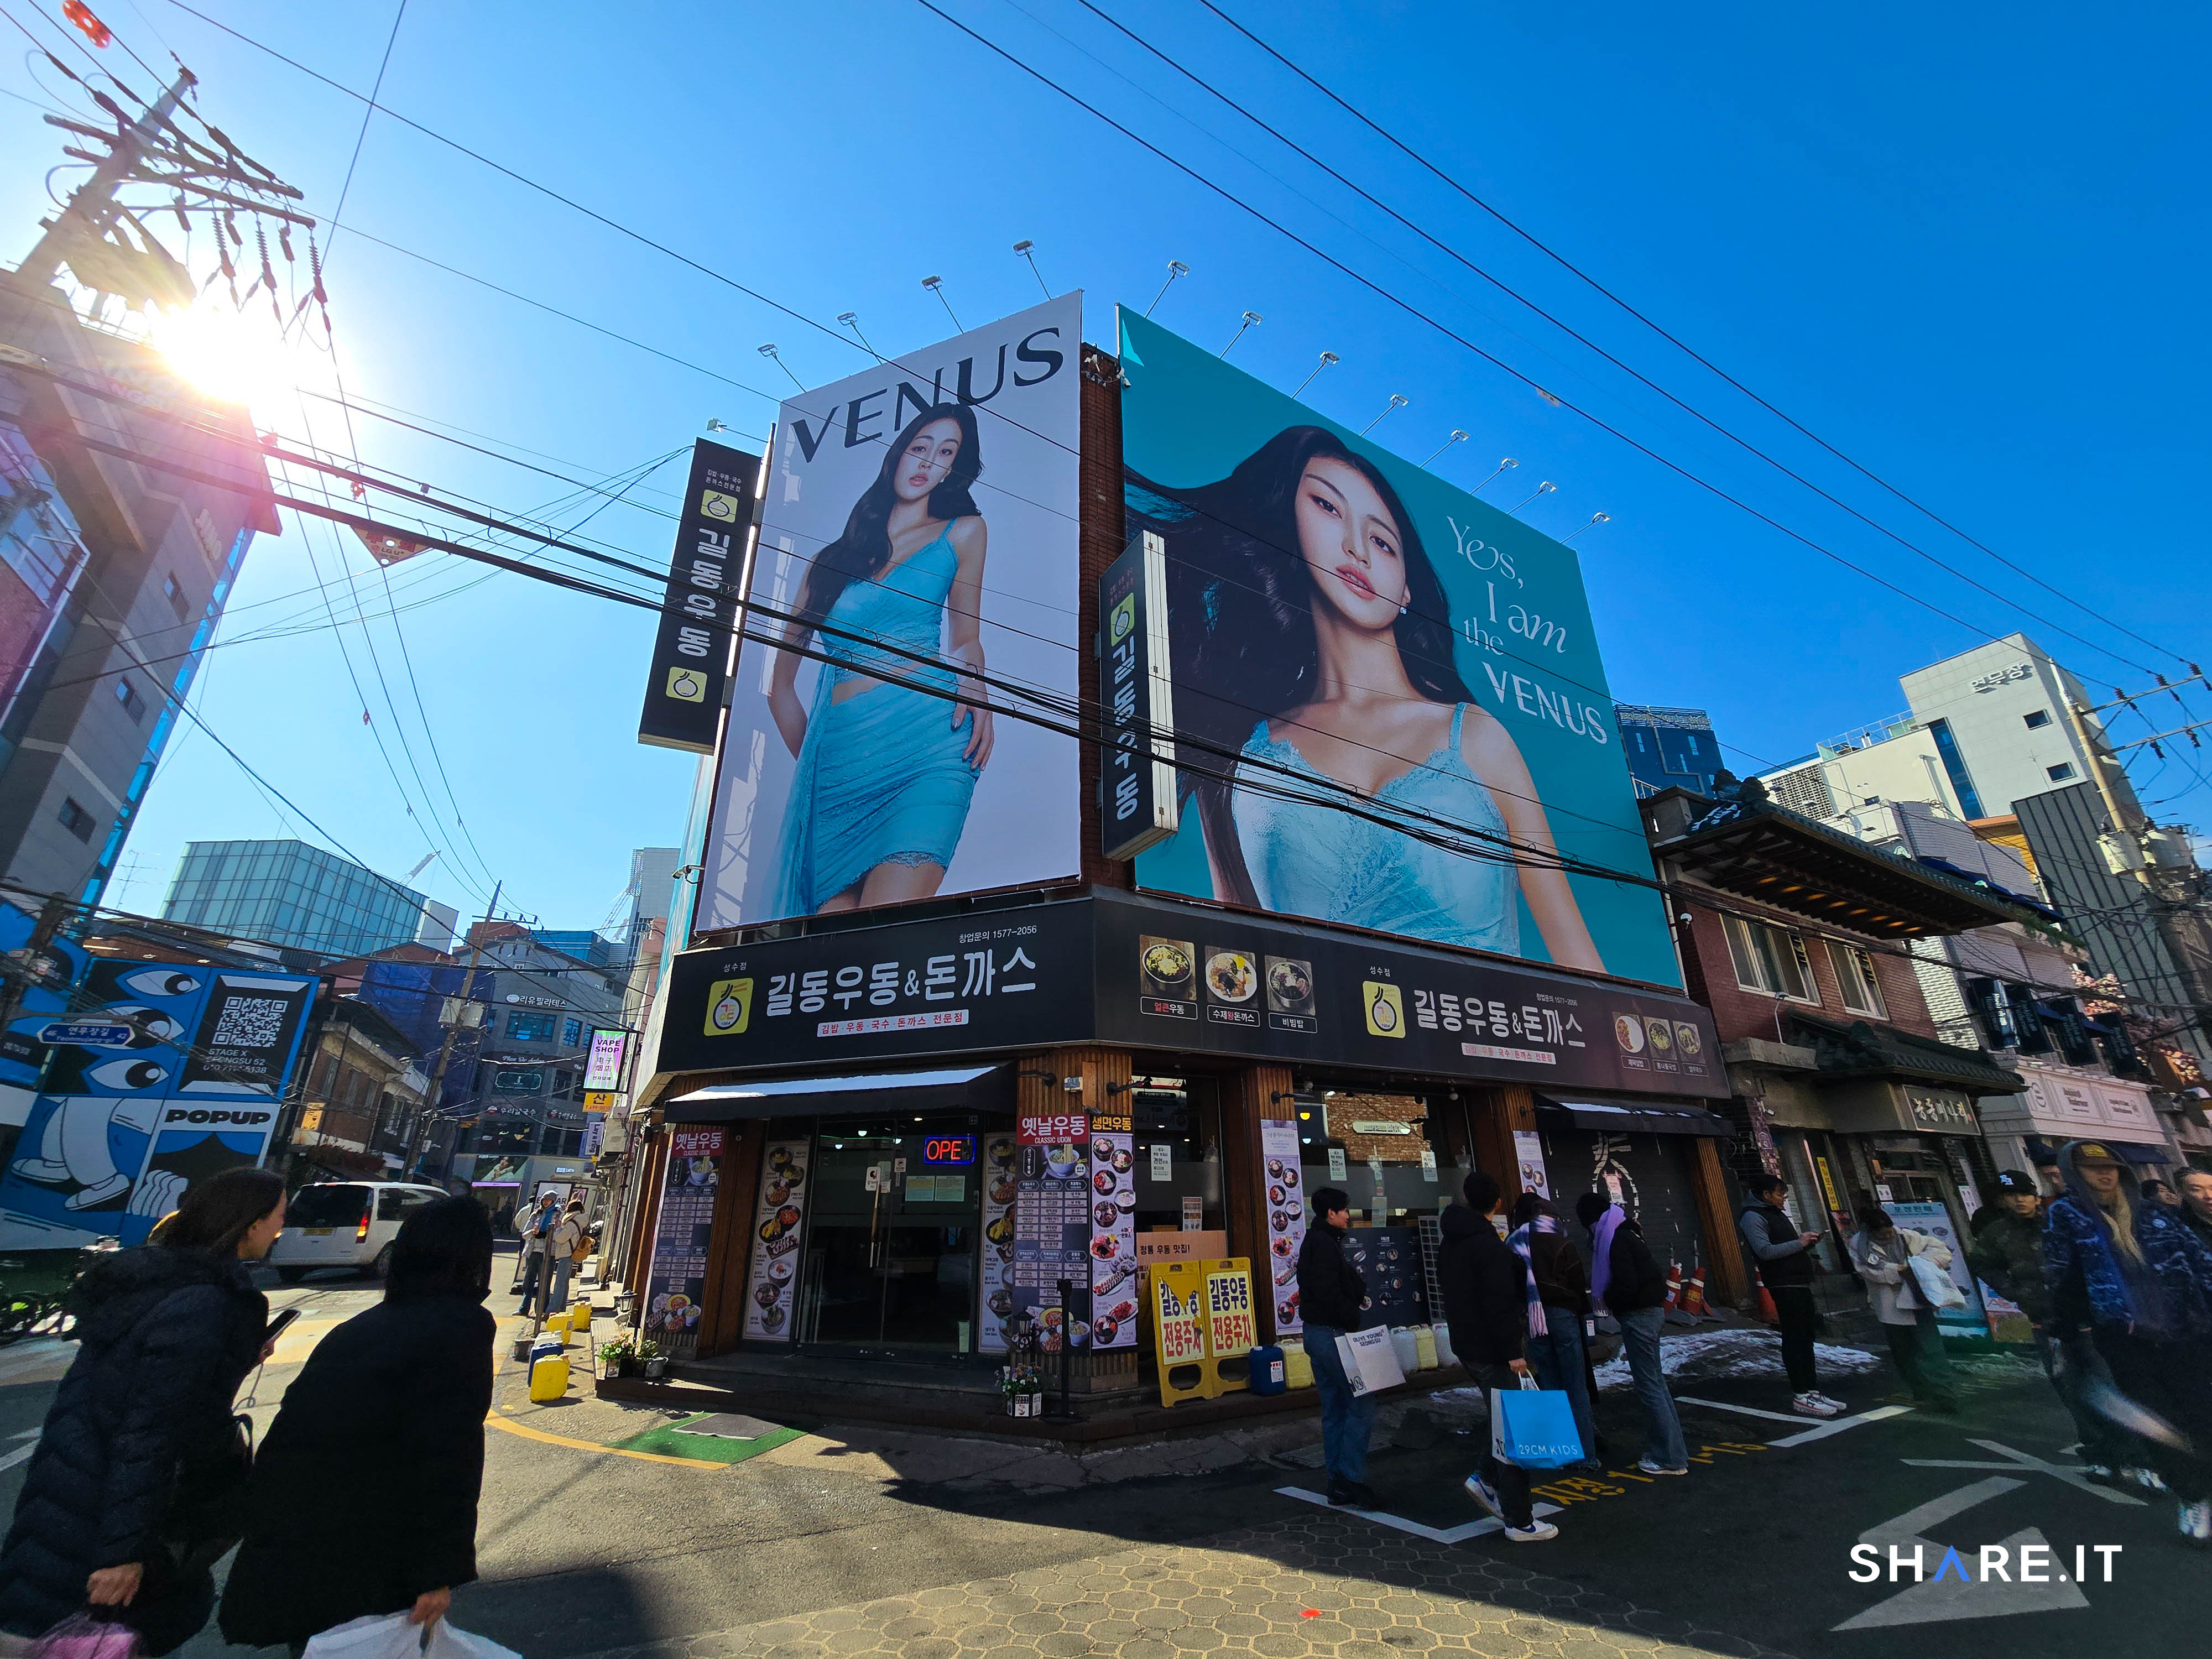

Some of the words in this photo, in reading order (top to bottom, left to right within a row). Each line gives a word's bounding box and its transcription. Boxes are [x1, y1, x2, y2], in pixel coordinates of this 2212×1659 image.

[791, 327, 1063, 463] VENUS
[1447, 515, 1524, 588] Yes,
[677, 528, 730, 658] 길동우동
[1486, 581, 1498, 623] I
[1508, 604, 1566, 653] am
[1463, 617, 1504, 655] the
[1971, 663, 2024, 692] 연무장
[1482, 661, 1607, 744] VENUS
[959, 930, 990, 944] 창업문의
[993, 925, 1037, 938] 1577-2056
[723, 962, 747, 973] 성수점
[1370, 966, 1391, 977] 성수점
[520, 996, 567, 1008] 리유필라테스
[1154, 1001, 1185, 1015] 얼큰우동
[1536, 993, 1554, 1004] 창업문의
[1554, 997, 1578, 1007] 1577-2056
[933, 1013, 963, 1024] 전문점
[1213, 1009, 1255, 1023] 수제왕돈까스
[1282, 1018, 1304, 1029] 비빔밥
[69, 1027, 110, 1037] 연무장길
[593, 1094, 607, 1105] 산
[164, 1109, 271, 1125] POPUP
[1092, 1115, 1131, 1131] 생면우동
[1022, 1116, 1085, 1137] 옛날우동
[676, 1132, 722, 1150] 옛날우동
[926, 1140, 964, 1160] OPE
[1157, 1245, 1170, 1254] 우동
[1173, 1244, 1190, 1254] 맛집!
[1209, 1277, 1248, 1312] 길동우동
[1213, 1314, 1252, 1350] 전용주차
[1366, 1332, 1383, 1340] YOUNG
[1360, 1338, 1381, 1347] SEONGSU
[1519, 1444, 1547, 1455] 29CM
[1550, 1444, 1578, 1455] KIDS
